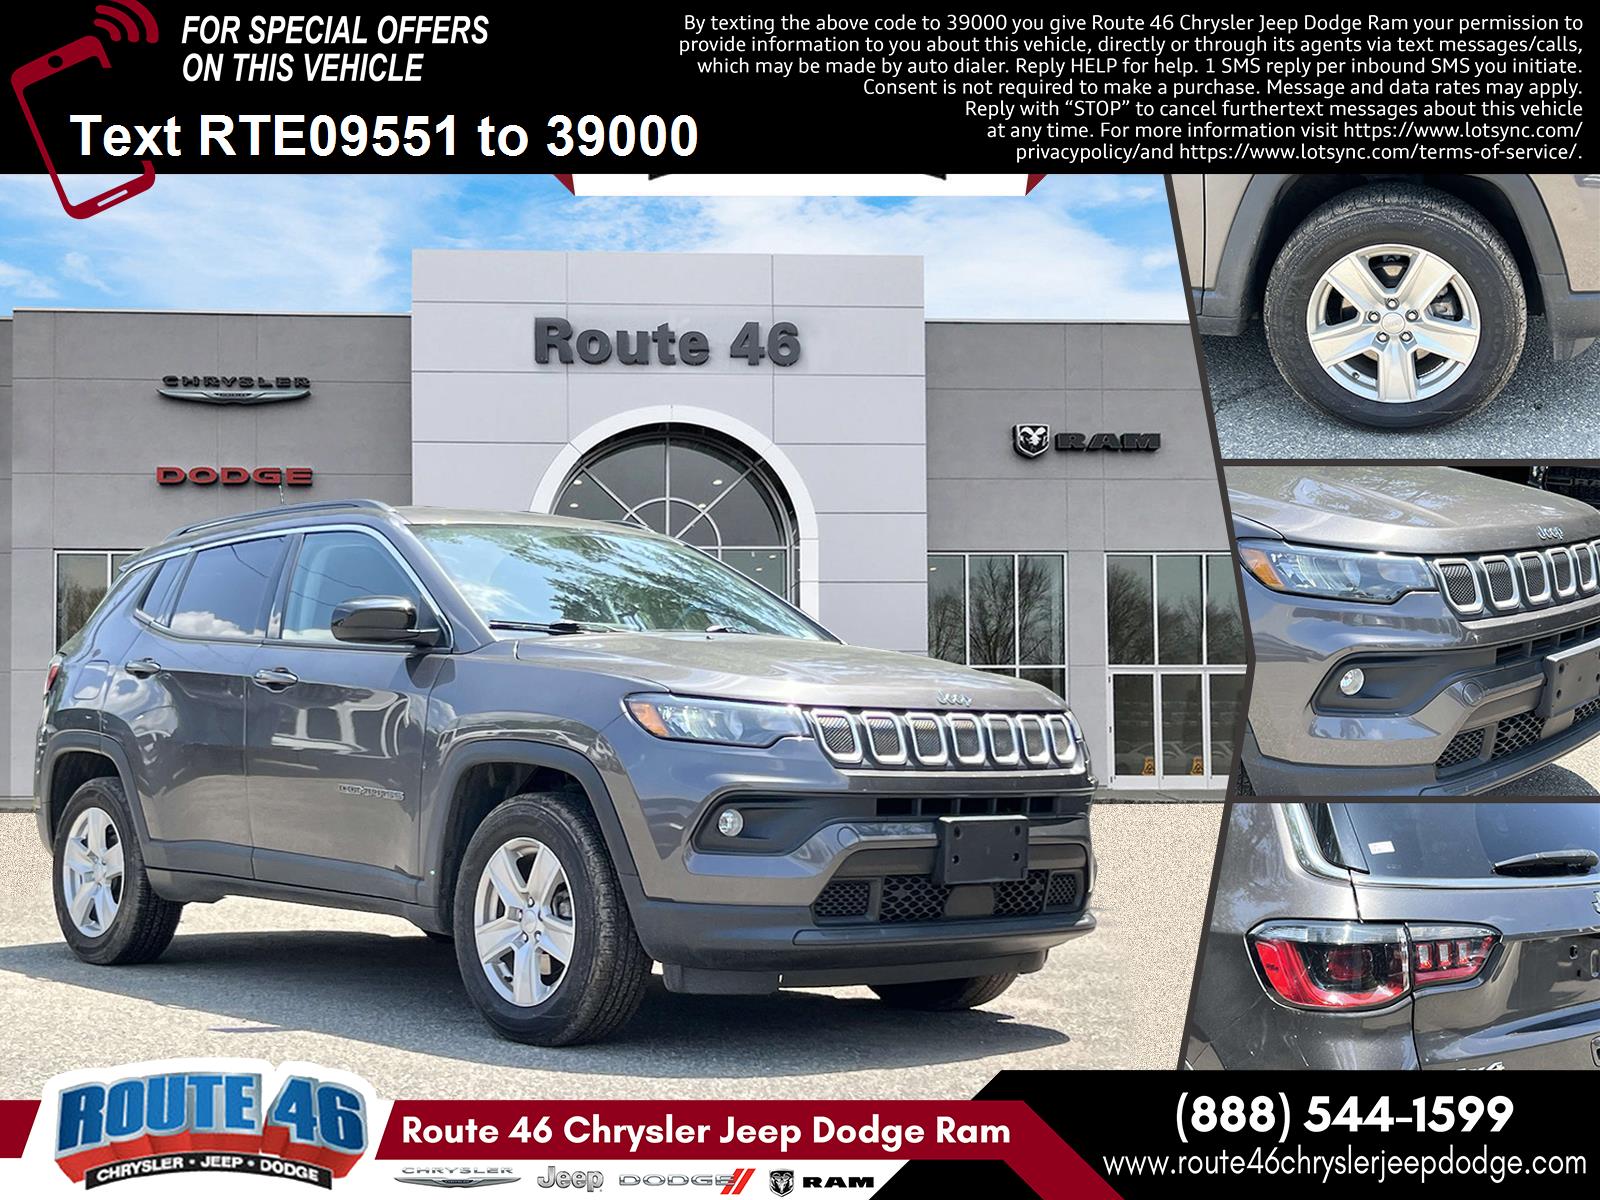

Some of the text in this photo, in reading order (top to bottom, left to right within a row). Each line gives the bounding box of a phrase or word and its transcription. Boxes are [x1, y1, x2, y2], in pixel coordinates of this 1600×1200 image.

[535, 317, 801, 367] Route 46
[162, 375, 311, 388] CHRYSLER
[1054, 432, 1161, 452] RAM
[156, 467, 313, 486] DODGE
[1537, 525, 1564, 541] Jeep
